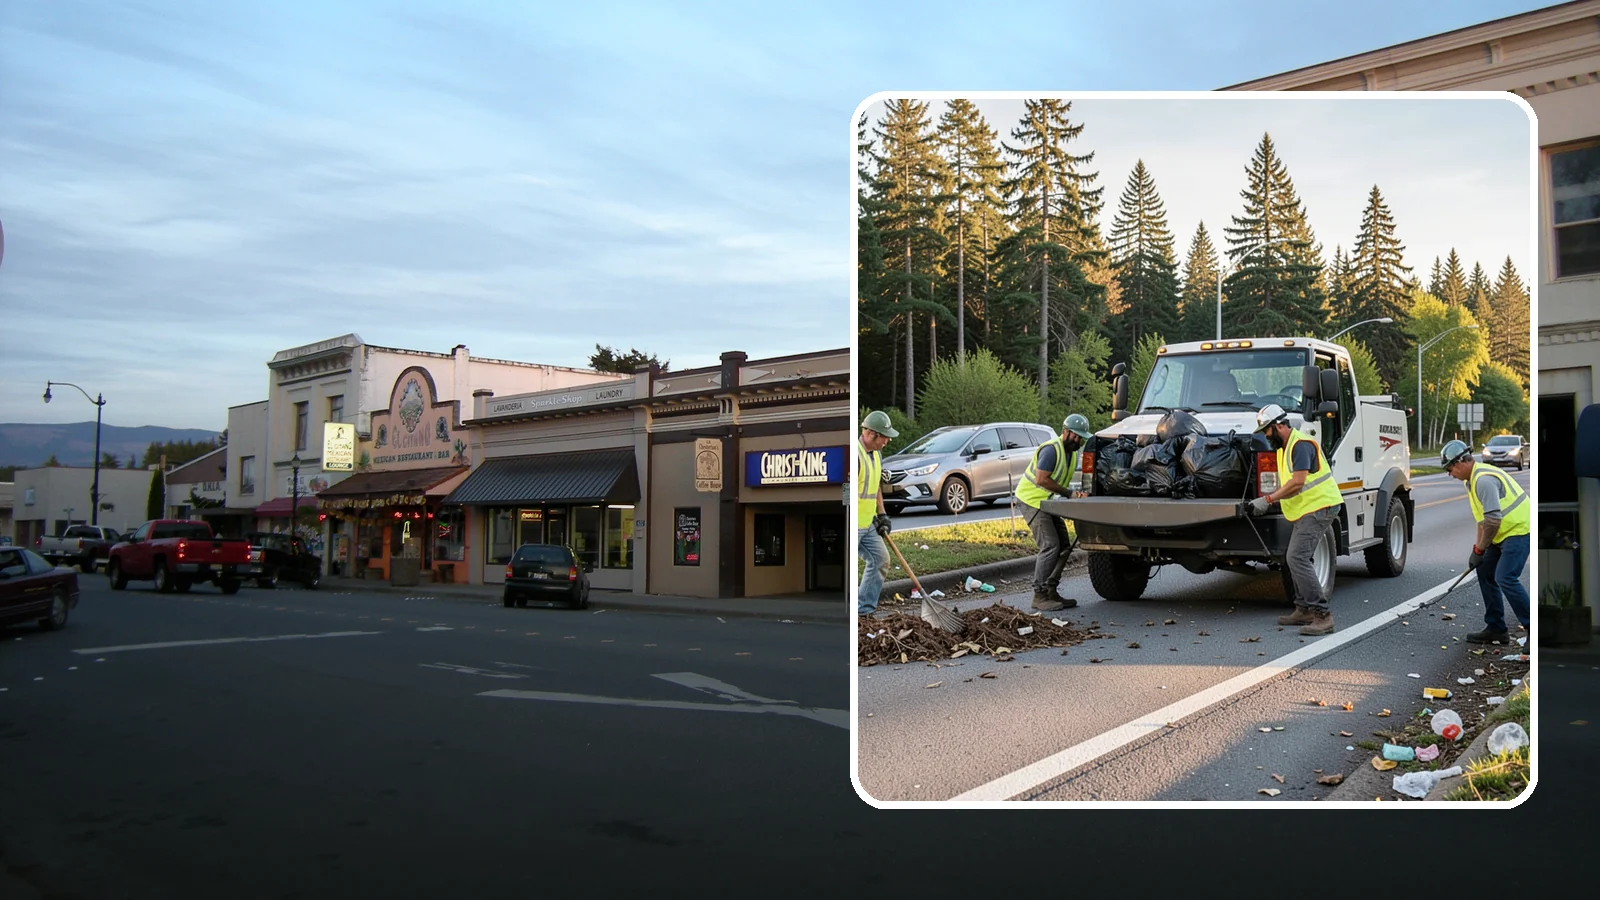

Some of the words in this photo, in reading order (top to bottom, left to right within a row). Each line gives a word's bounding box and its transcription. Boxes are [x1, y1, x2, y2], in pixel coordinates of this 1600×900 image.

[530, 396, 562, 409] Sparkle
[561, 394, 583, 405] Shop
[595, 389, 624, 400] LAUNDRY
[493, 402, 523, 412] LAVANDERIA
[373, 455, 396, 464] MEXICAN
[397, 451, 434, 462] RESTAURANT
[437, 450, 450, 459] BAR
[761, 452, 797, 478] CHRIST
[799, 450, 827, 476] KING
